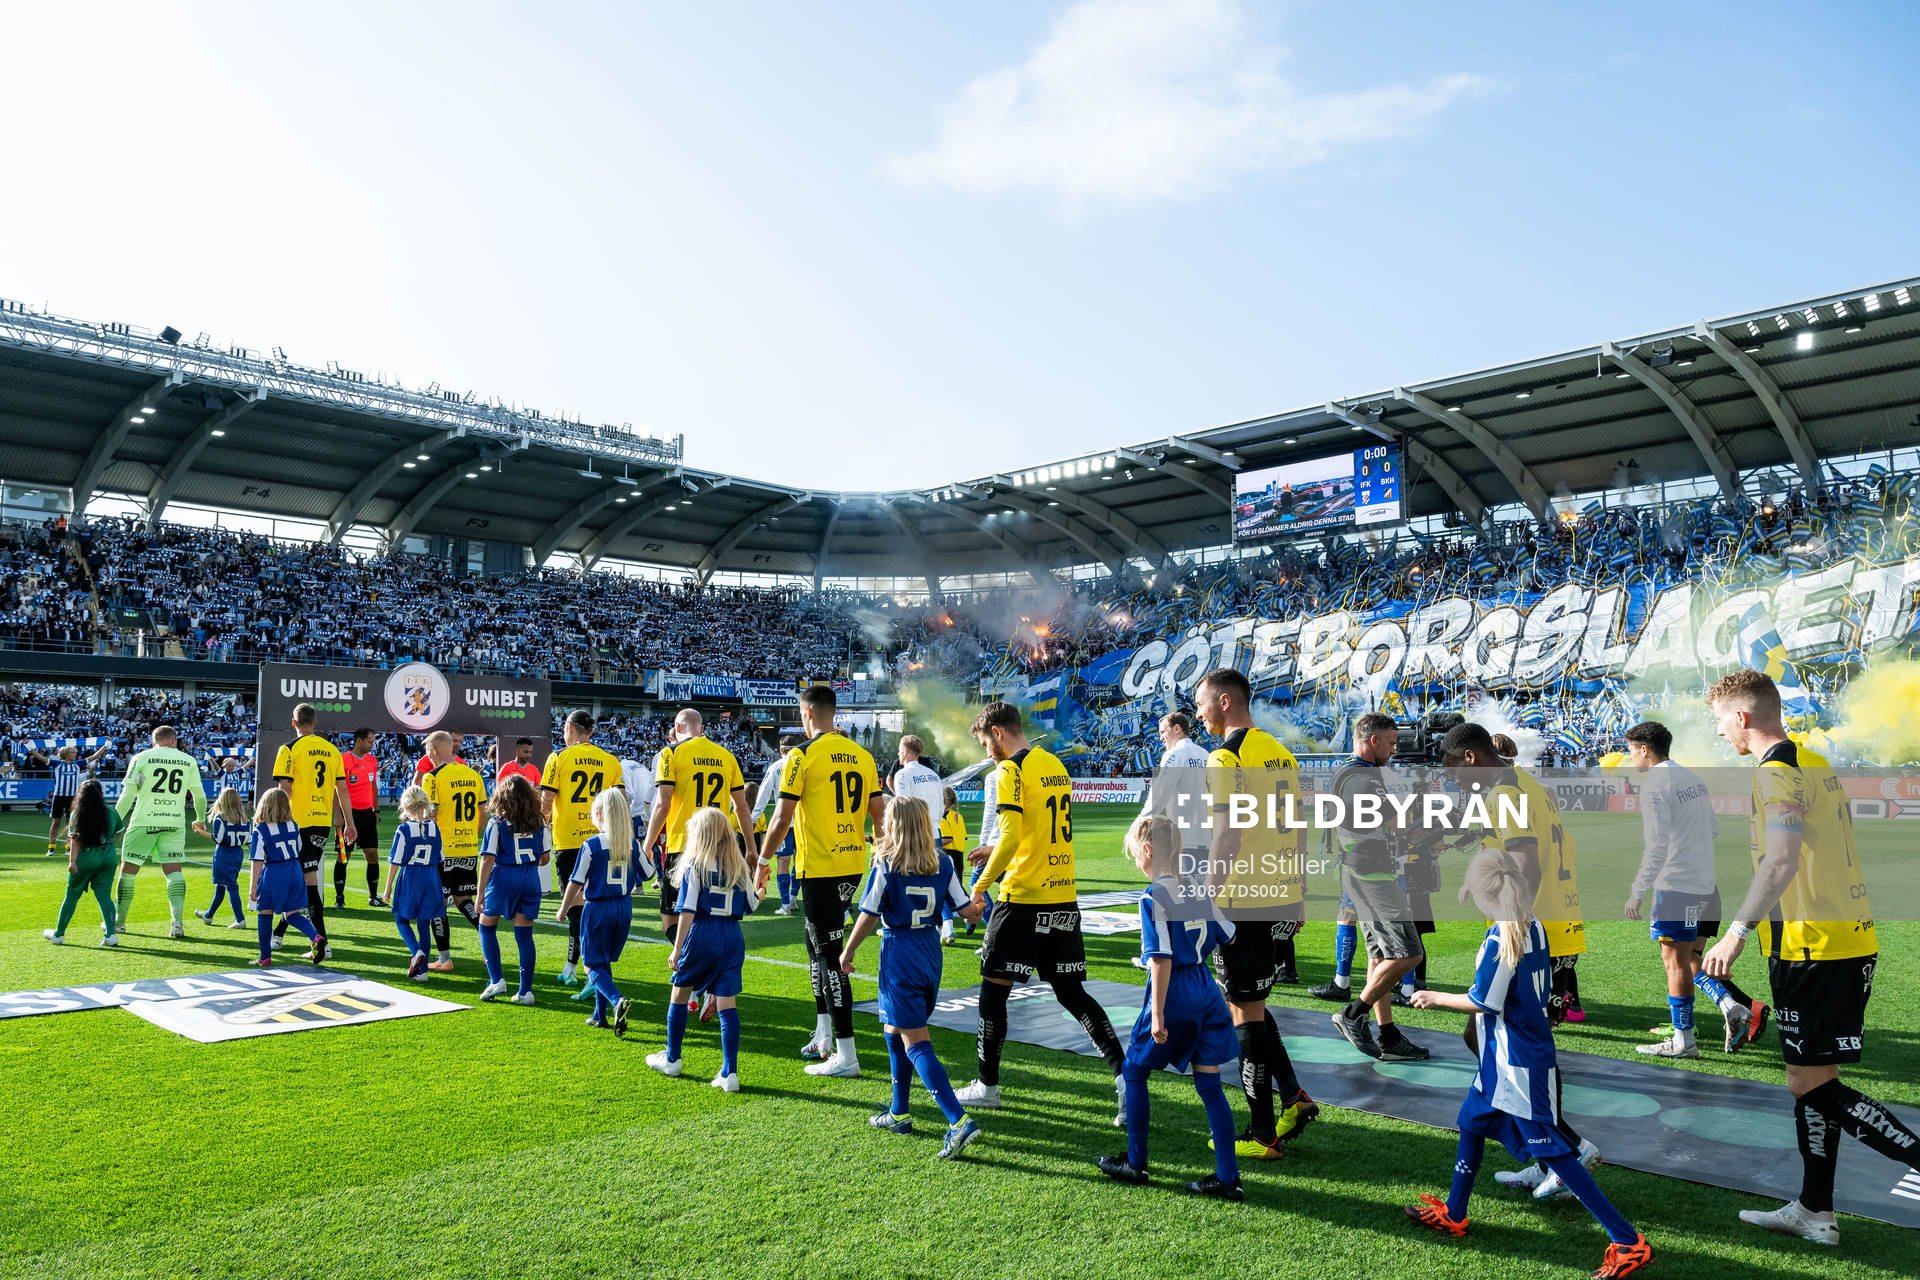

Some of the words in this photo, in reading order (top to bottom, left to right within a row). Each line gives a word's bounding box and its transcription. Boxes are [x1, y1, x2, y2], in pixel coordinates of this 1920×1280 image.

[1364, 447, 1387, 460] 0:00
[1381, 477, 1395, 485] BKH
[465, 518, 490, 529] F3
[1257, 522, 1289, 534] GLÖMMER
[1289, 519, 1313, 530] ALDRIG
[1313, 517, 1338, 526] DENNA
[1338, 513, 1355, 523] STAD
[642, 543, 664, 553] F2
[1121, 556, 1920, 700] GÖTEBORGSLAGET
[280, 679, 368, 701] UNIBET
[465, 688, 538, 708] UNIBET
[151, 767, 184, 795] 26
[314, 760, 326, 789] 3
[570, 770, 605, 804] 24
[1040, 775, 1071, 788] SANDBER
[692, 771, 724, 808] 12
[830, 770, 864, 814] 19
[1071, 792, 1137, 803] INTERSPORT
[1557, 780, 1616, 796] morris
[452, 791, 477, 822] 18
[1046, 793, 1073, 844] 13
[275, 840, 299, 860] 11
[1048, 853, 1072, 866] brio
[905, 885, 936, 929] 2
[1184, 918, 1208, 964] 7
[1005, 961, 1034, 976] KBYG
[827, 969, 843, 1007] MAXXIS
[976, 1016, 986, 1062] MAXXIS
[1850, 1101, 1917, 1150] MAXXIS
